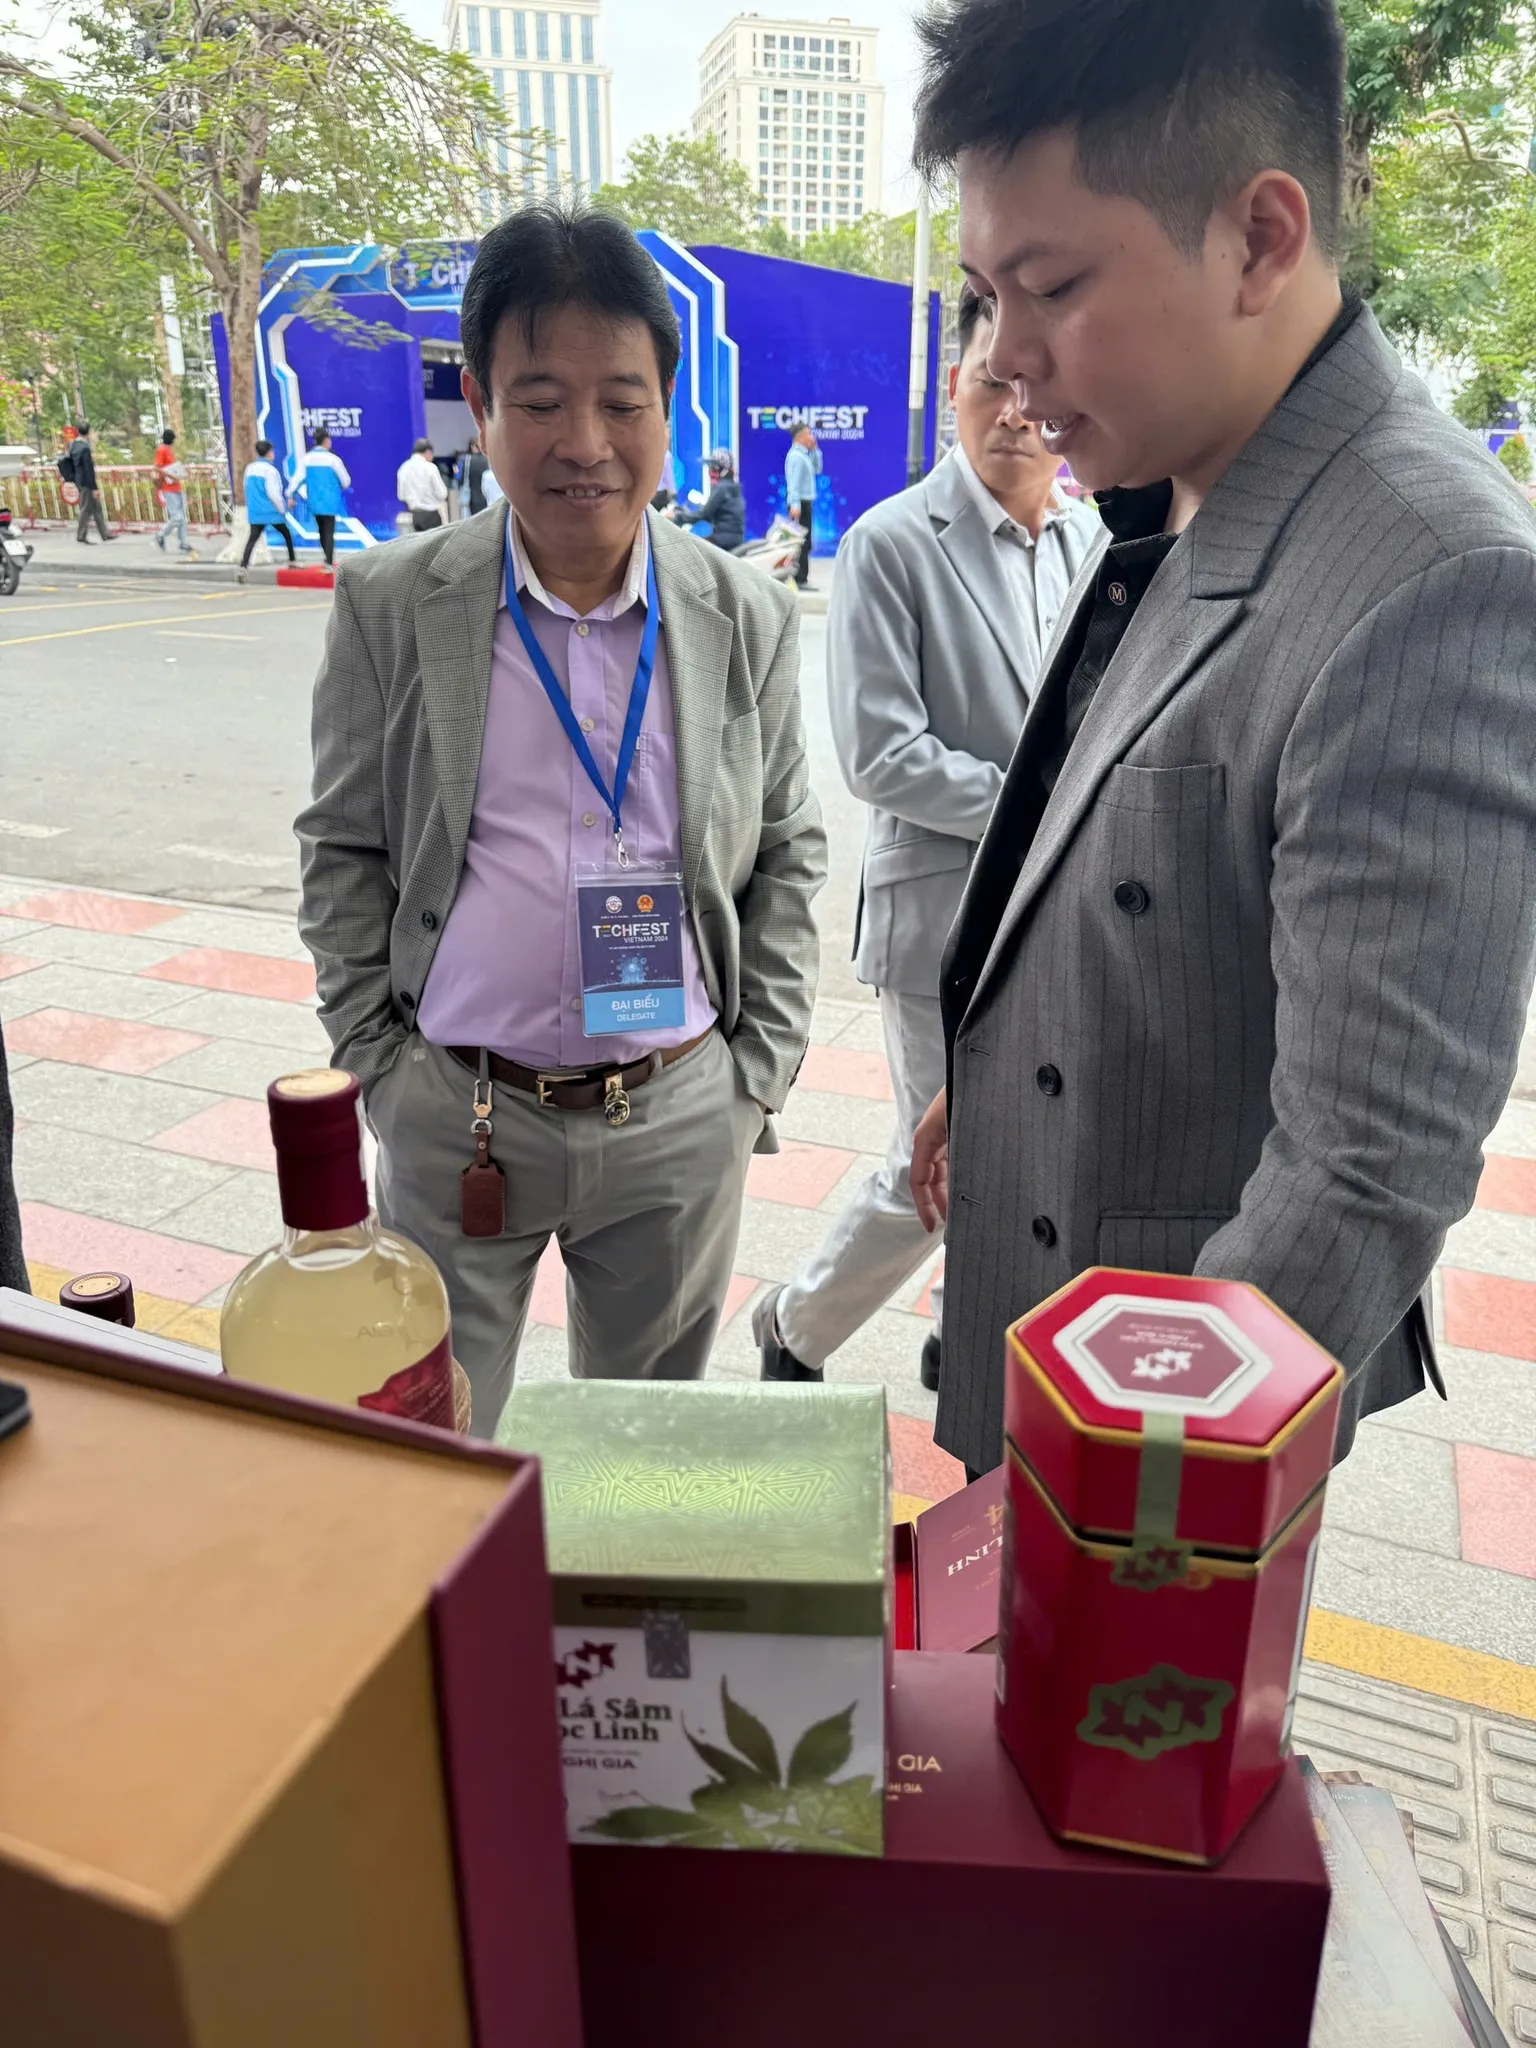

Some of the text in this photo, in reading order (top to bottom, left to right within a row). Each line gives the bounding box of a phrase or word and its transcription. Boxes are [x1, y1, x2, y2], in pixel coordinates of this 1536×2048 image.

[747, 405, 868, 429] TECHFEST
[592, 922, 669, 938] TECHFEST
[611, 1000, 630, 1013] ĐẠI
[616, 1012, 656, 1022] DELEGATE
[560, 1696, 672, 1721] Lá Sâm
[594, 1721, 659, 1742] Linh
[602, 1758, 636, 1770] GIA
[898, 1754, 942, 1771] GIA
